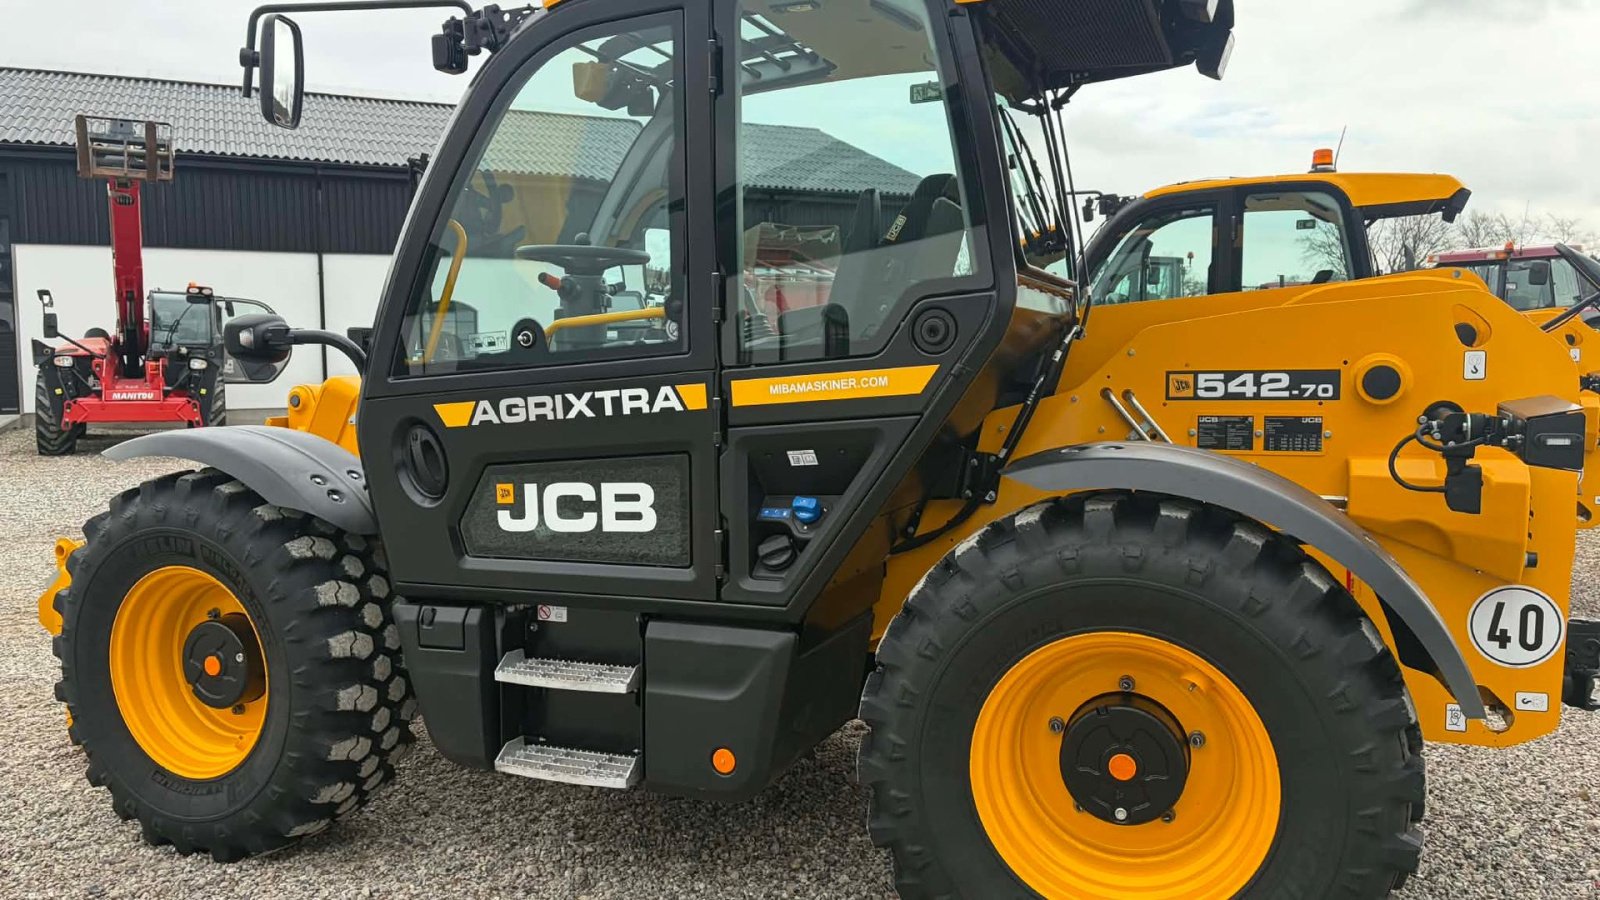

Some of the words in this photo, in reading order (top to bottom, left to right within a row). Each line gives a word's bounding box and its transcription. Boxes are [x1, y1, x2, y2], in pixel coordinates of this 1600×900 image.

[888, 216, 906, 240] JCB
[112, 392, 154, 400] MANITOU
[769, 375, 889, 395] MIBAMASKINER.COM
[1174, 379, 1191, 393] JCB
[471, 385, 685, 426] AGRIXTRA
[497, 482, 657, 532] JCB
[1487, 602, 1544, 651] 40
